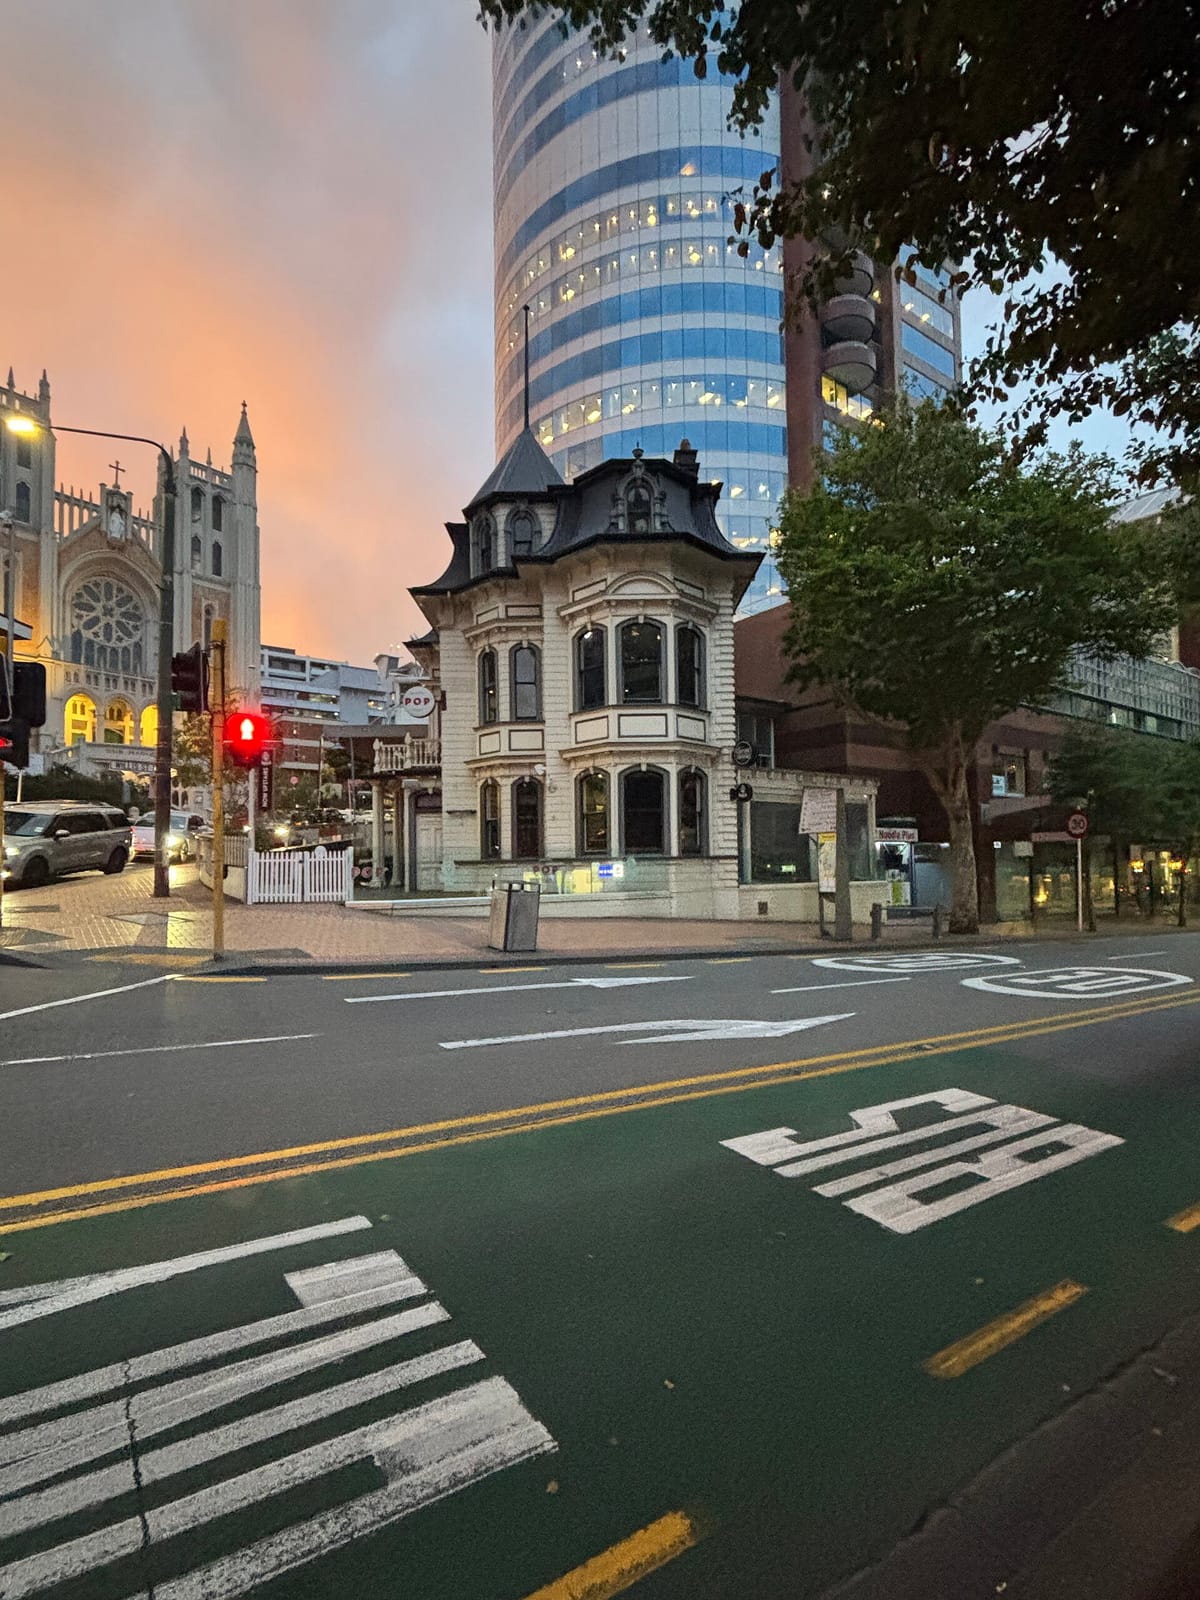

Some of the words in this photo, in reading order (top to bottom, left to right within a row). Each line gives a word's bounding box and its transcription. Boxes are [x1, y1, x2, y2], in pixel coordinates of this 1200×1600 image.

[404, 697, 431, 706] POP
[1071, 818, 1086, 830] 30
[902, 830, 915, 841] Plus
